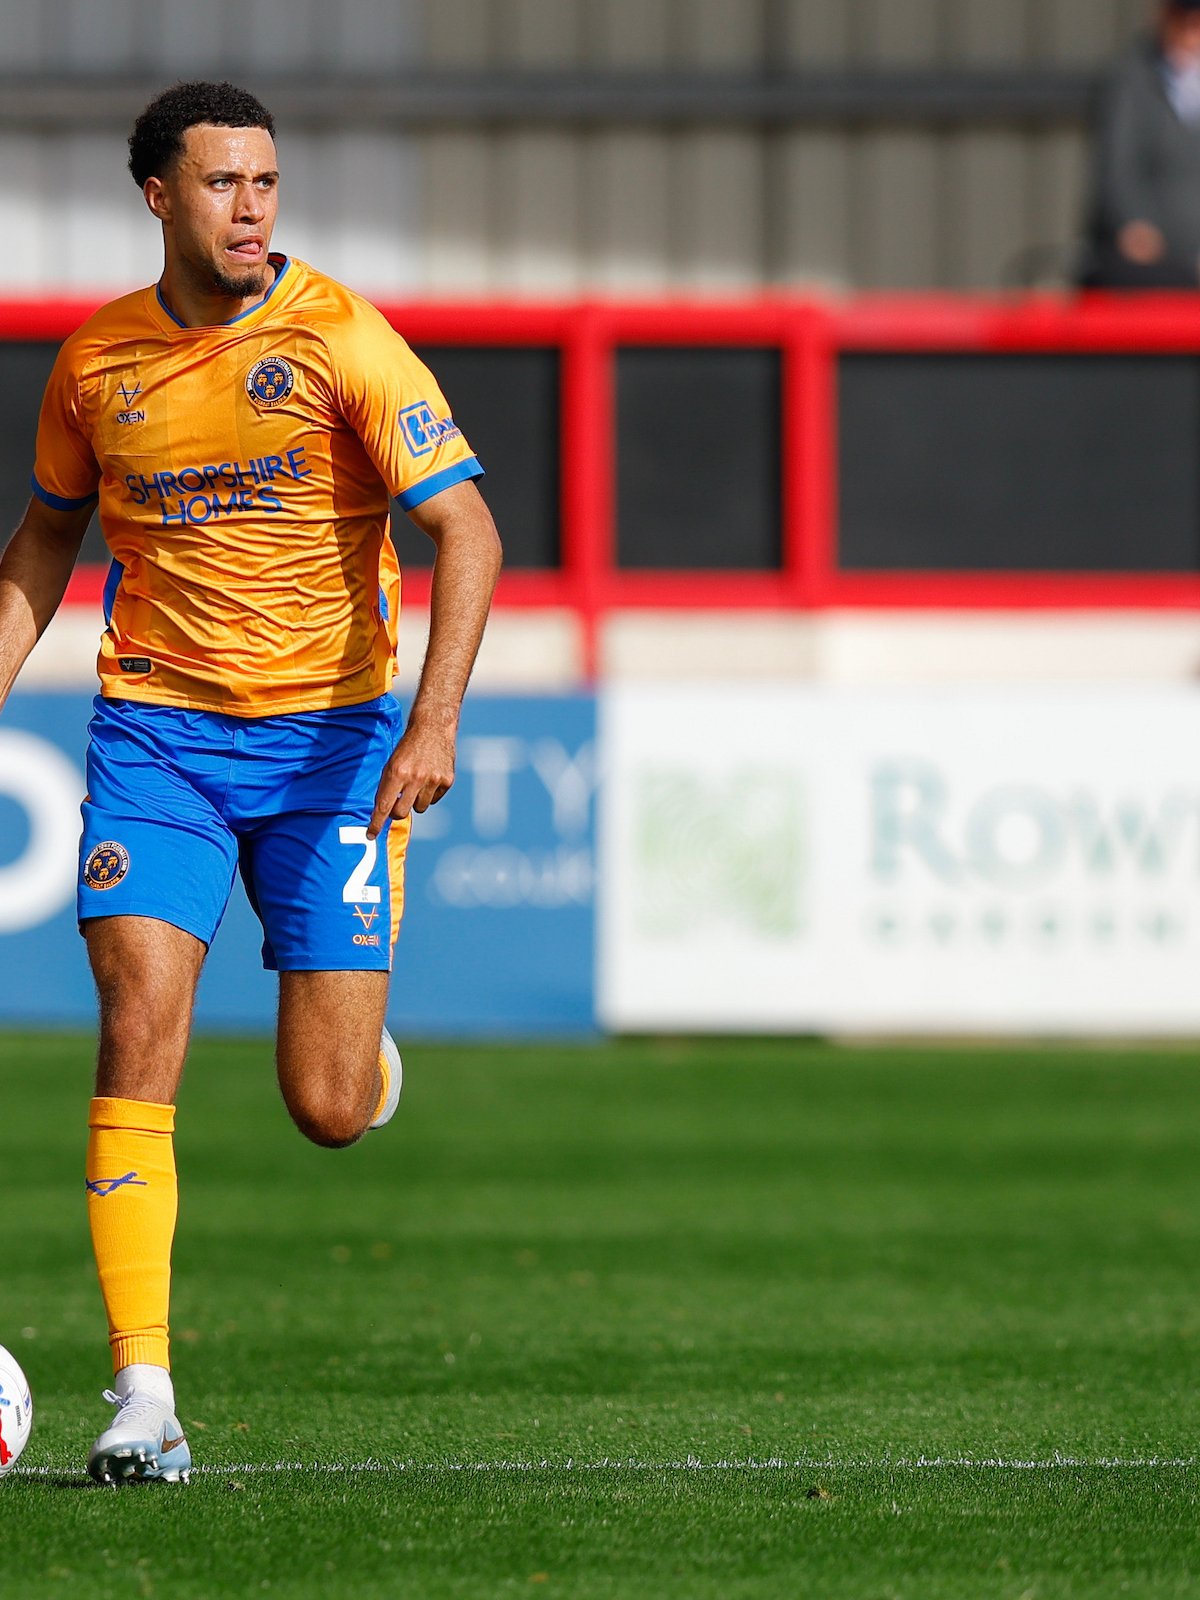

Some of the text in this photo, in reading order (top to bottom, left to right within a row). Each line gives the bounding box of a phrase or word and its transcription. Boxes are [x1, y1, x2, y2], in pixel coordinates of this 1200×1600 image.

[116, 410, 145, 425] OXEN
[125, 446, 312, 504] SHROPSHIRE
[160, 486, 282, 526] HOMES
[338, 826, 381, 903] 2
[352, 934, 379, 946] OXEN
